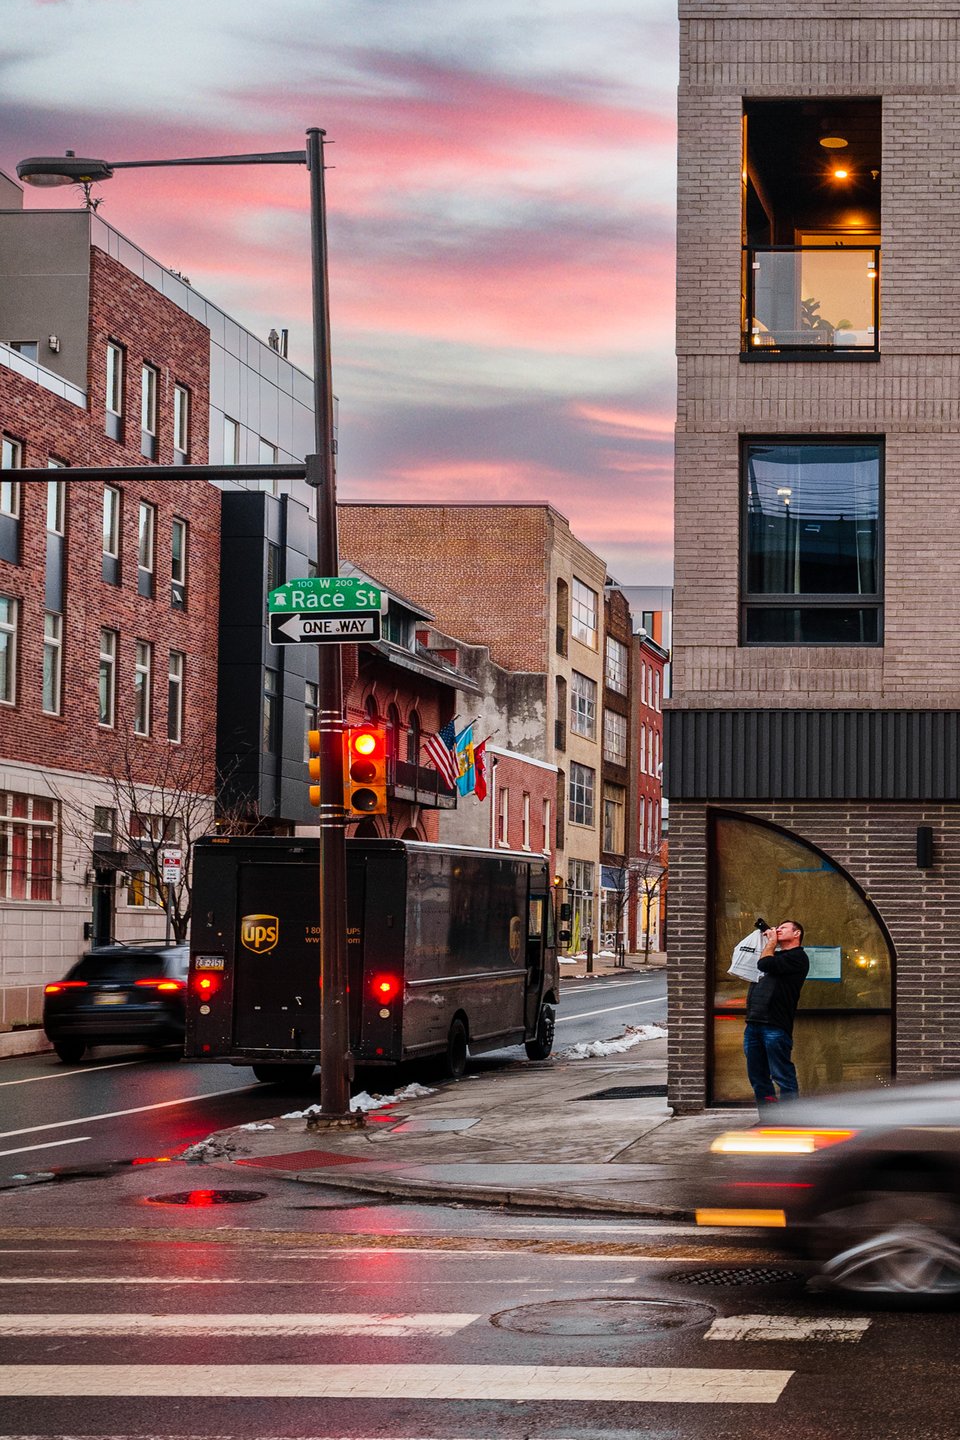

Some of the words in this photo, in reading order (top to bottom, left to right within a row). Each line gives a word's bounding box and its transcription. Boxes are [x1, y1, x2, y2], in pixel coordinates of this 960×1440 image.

[319, 579, 331, 589] W
[335, 579, 354, 587] 200
[291, 590, 345, 608] Race
[355, 589, 377, 607] St
[303, 621, 332, 634] ONE
[339, 620, 367, 634] WAY
[244, 926, 276, 948] ups
